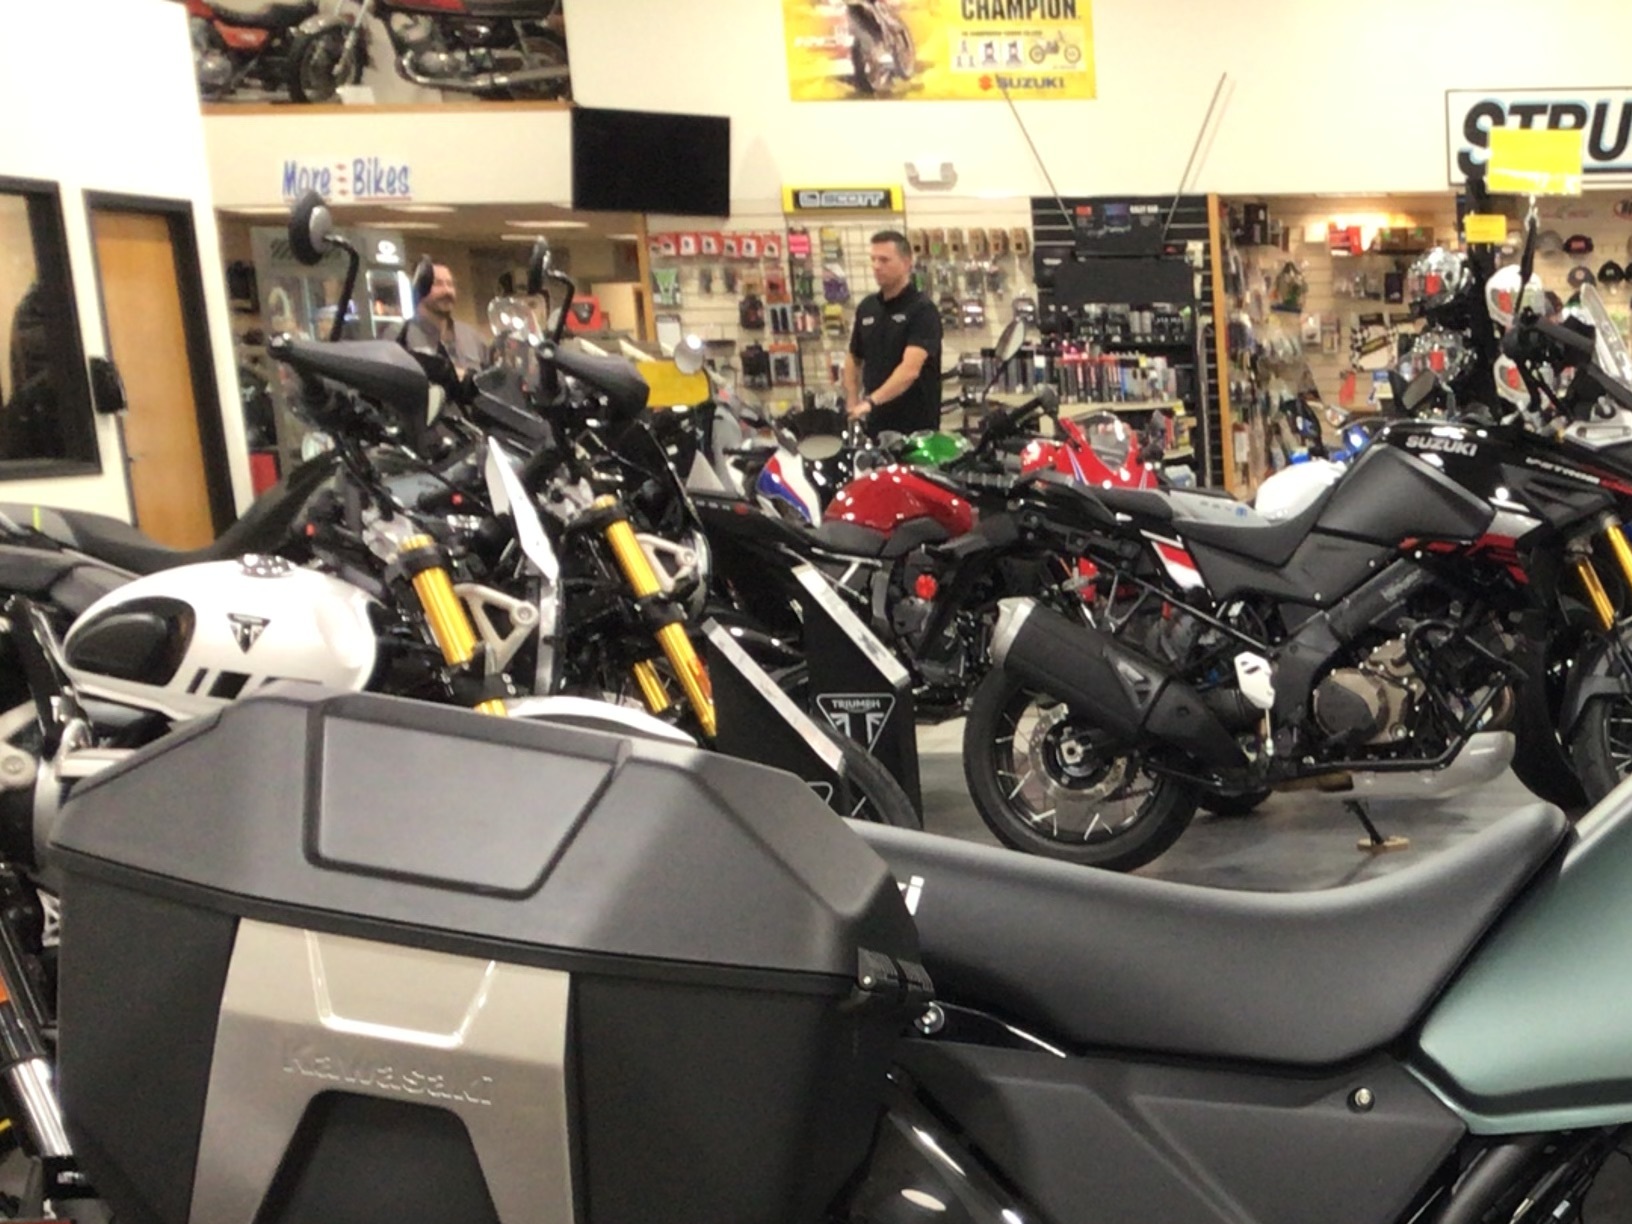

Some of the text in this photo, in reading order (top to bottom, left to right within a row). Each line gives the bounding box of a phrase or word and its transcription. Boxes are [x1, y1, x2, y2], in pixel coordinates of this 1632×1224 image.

[961, 0, 1077, 20] CHAMPION
[997, 76, 1065, 89] SUZUKI
[283, 157, 410, 197] More Bikes
[821, 190, 885, 207] SCOTT
[1405, 434, 1478, 457] SUZUKI
[831, 698, 881, 710] TRIUMPH
[283, 1047, 493, 1106] Kawasaki
